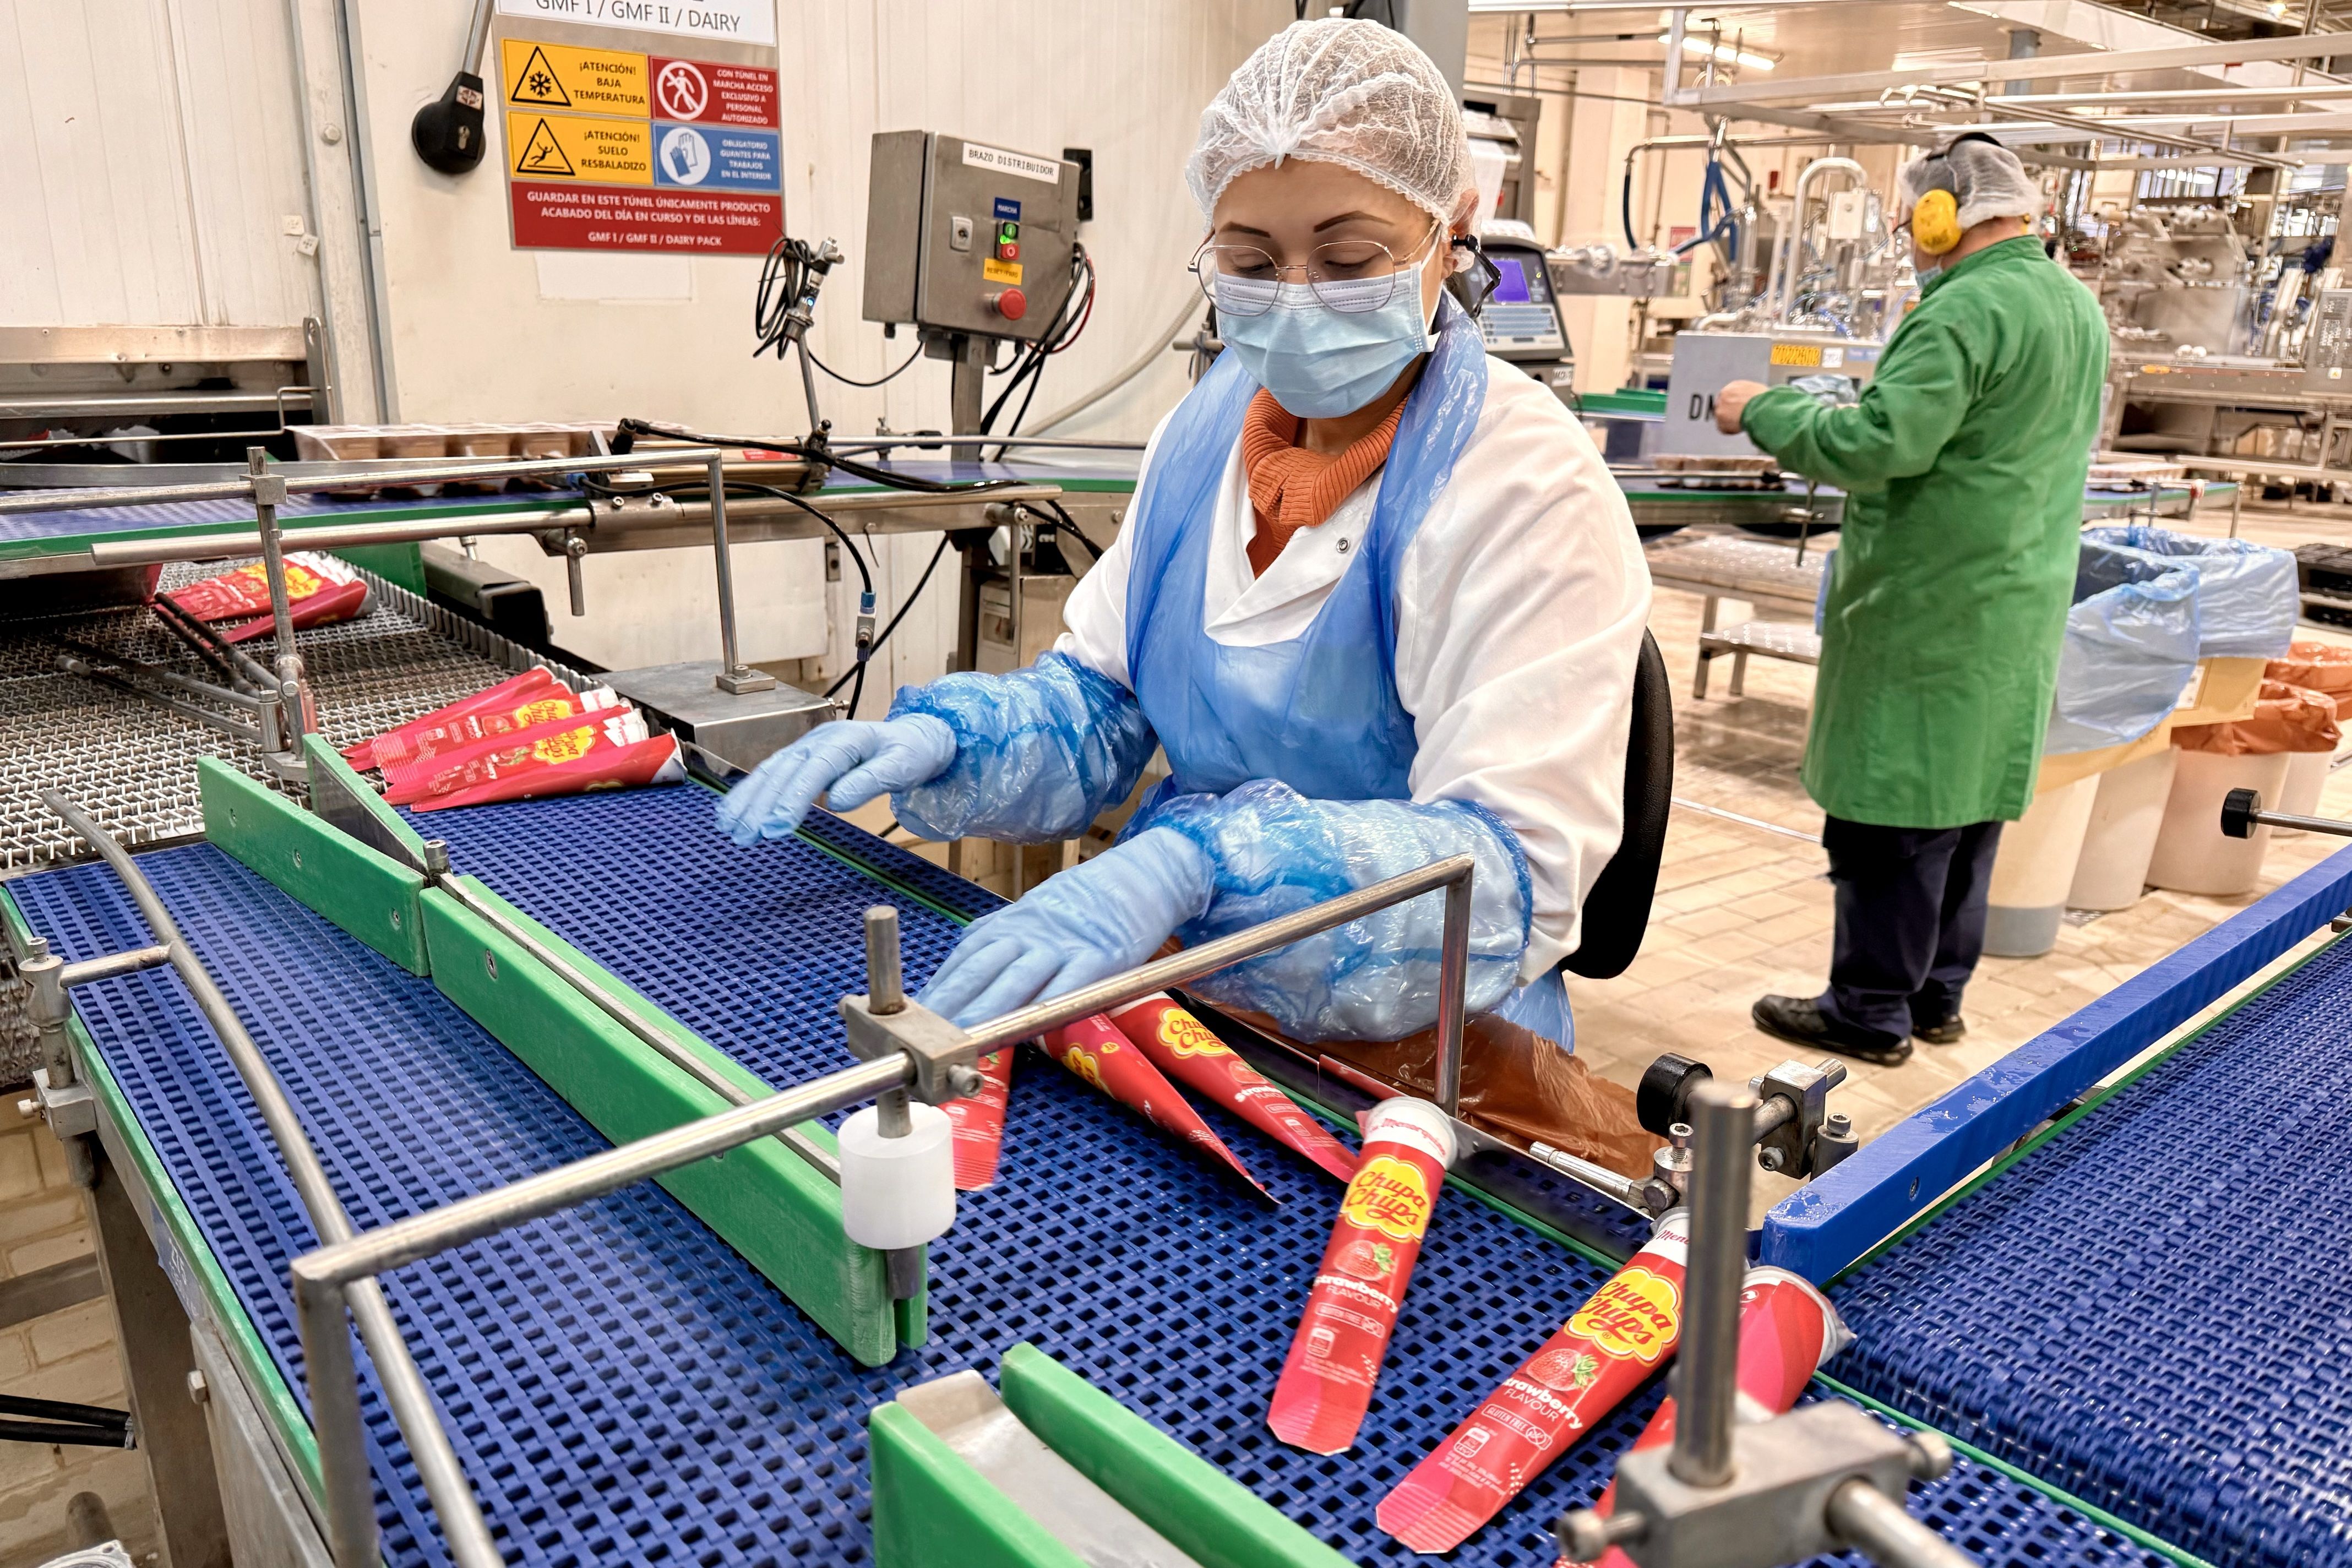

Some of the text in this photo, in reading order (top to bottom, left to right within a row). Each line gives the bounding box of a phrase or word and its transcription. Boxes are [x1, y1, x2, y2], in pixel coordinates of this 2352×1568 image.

[612, 1, 652, 21] GMF
[659, 6, 669, 24] II
[675, 9, 682, 27] /
[688, 10, 740, 32] DAIRY
[580, 61, 636, 75] ¡ATENCIÓN!
[717, 69, 734, 78] CON
[758, 73, 769, 81] EN
[596, 77, 622, 88] BAJA
[712, 79, 774, 92] MARCHA ACCESO
[574, 89, 645, 105] TEMPERATURA
[721, 91, 760, 102] EXCLUSIVO
[726, 102, 763, 113] PERSONAL
[721, 113, 768, 124] AUTORIZADO
[584, 130, 640, 143] ¡ATENCIÓN!
[598, 145, 628, 156] SUELO
[722, 139, 768, 150] OBLIGATORIO
[720, 149, 752, 159] GUANTES
[581, 159, 646, 171] RESBALADIZO
[729, 160, 764, 170] TRABAJOS
[969, 149, 1054, 176] BRAZO DISTRIBUIDOR
[721, 170, 731, 178] EN
[740, 170, 772, 181] INTERIOR
[527, 191, 771, 213] GUARDAR EN ESTE TÚNEL ÚNICAMENTE PRODUCTO
[541, 206, 592, 219] ACABADO
[594, 209, 613, 220] DEL
[615, 208, 633, 221] DÍA
[635, 211, 649, 221] EN
[651, 212, 683, 224] CURSO
[684, 214, 692, 224] Y
[693, 214, 706, 225] DE
[707, 214, 725, 225] LAS
[588, 231, 722, 246] GMF I / GMF II / DAIRY PACK
[1356, 1171, 1427, 1211] Chupa
[1346, 1188, 1420, 1227] Chups
[1326, 1285, 1382, 1310] FLAVOUR
[1596, 1282, 1673, 1331] Chupa
[1575, 1298, 1655, 1345] Chups
[1504, 1388, 1560, 1423] FLAVOUR
[1487, 1406, 1512, 1423] GLUTEN
[1510, 1418, 1529, 1432] FREE
